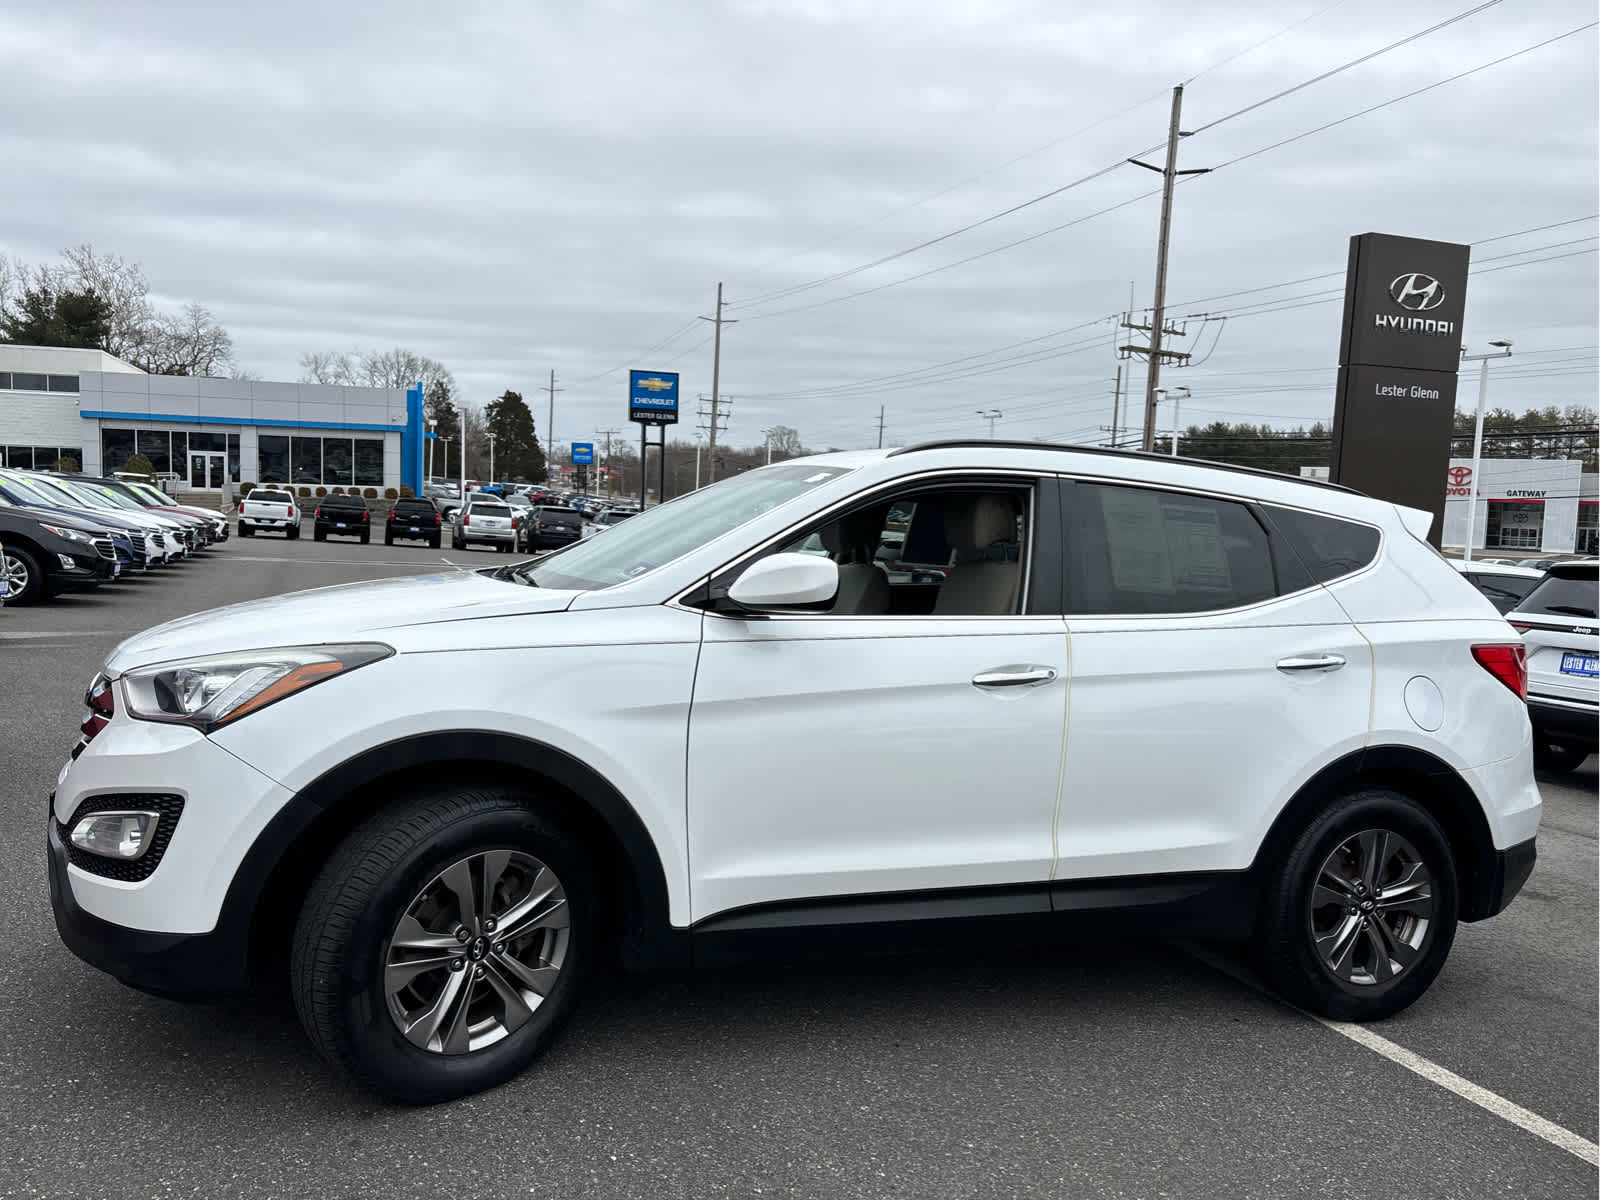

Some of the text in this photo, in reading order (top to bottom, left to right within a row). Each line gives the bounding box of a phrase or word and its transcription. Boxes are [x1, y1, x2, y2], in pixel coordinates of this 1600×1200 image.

[1375, 313, 1454, 334] HYUNDAI
[1375, 383, 1440, 400] Lester Glenn
[633, 397, 674, 406] CHEVROLET
[1446, 487, 1480, 496] OYOT
[1506, 490, 1547, 498] GATEWAY
[1573, 626, 1591, 635] Jeep
[1563, 655, 1583, 670] LESTER
